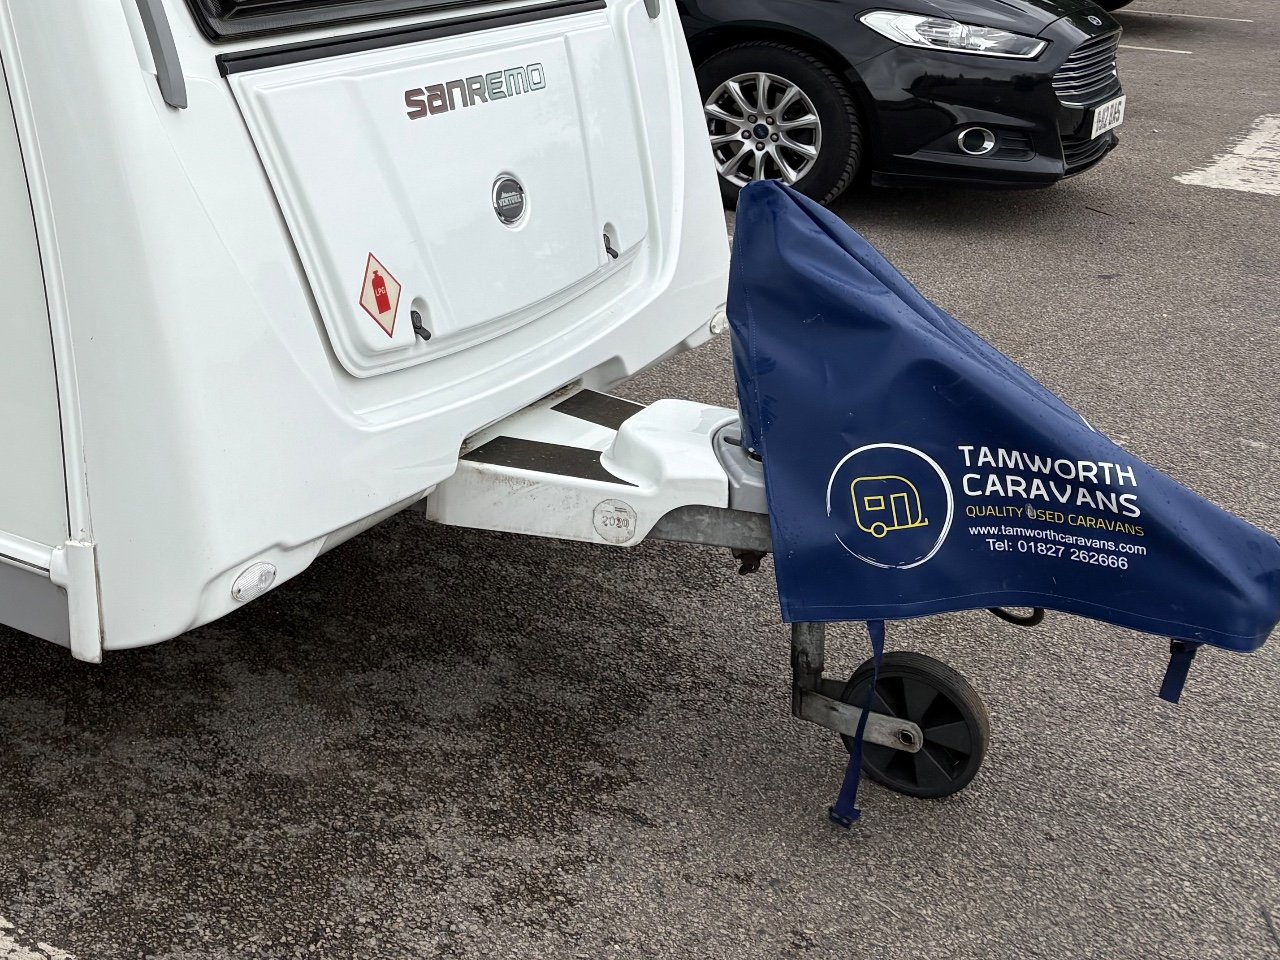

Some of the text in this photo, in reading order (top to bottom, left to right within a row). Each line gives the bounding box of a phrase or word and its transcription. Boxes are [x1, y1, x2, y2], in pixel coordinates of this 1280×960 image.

[375, 286, 387, 297] LPG
[958, 445, 1138, 487] TAMWORTH
[962, 473, 1141, 518] CARAVANS
[965, 505, 1145, 537] QUALITY USED CARAVANS
[968, 525, 1147, 555] www.tamworthcaravans.com
[985, 539, 1129, 570] Tel: 01827 262666
